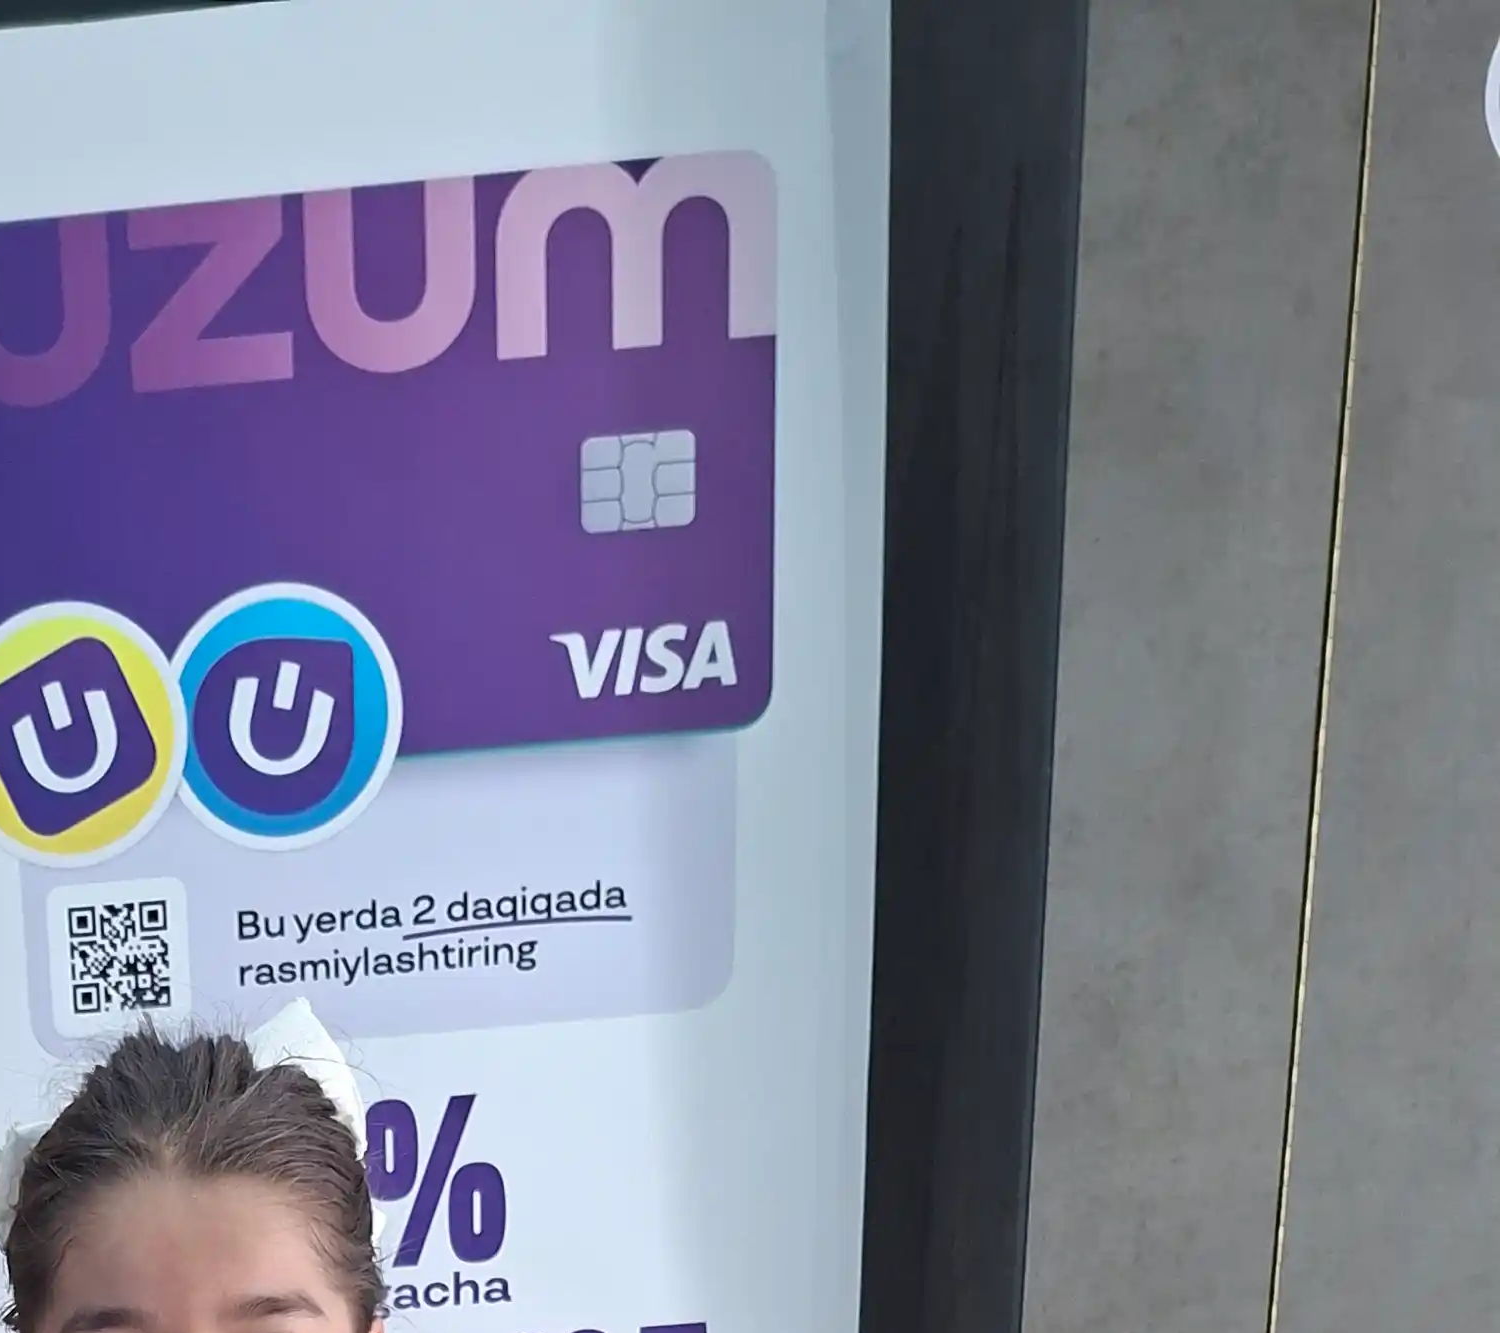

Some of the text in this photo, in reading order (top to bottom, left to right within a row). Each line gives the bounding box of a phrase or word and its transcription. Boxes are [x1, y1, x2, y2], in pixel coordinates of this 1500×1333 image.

[548, 619, 739, 699] VISA
[411, 894, 437, 926] 2
[446, 879, 628, 923] daqiqada
[238, 936, 539, 987] rasmiylashtiring
[386, 1271, 512, 1310] acha
